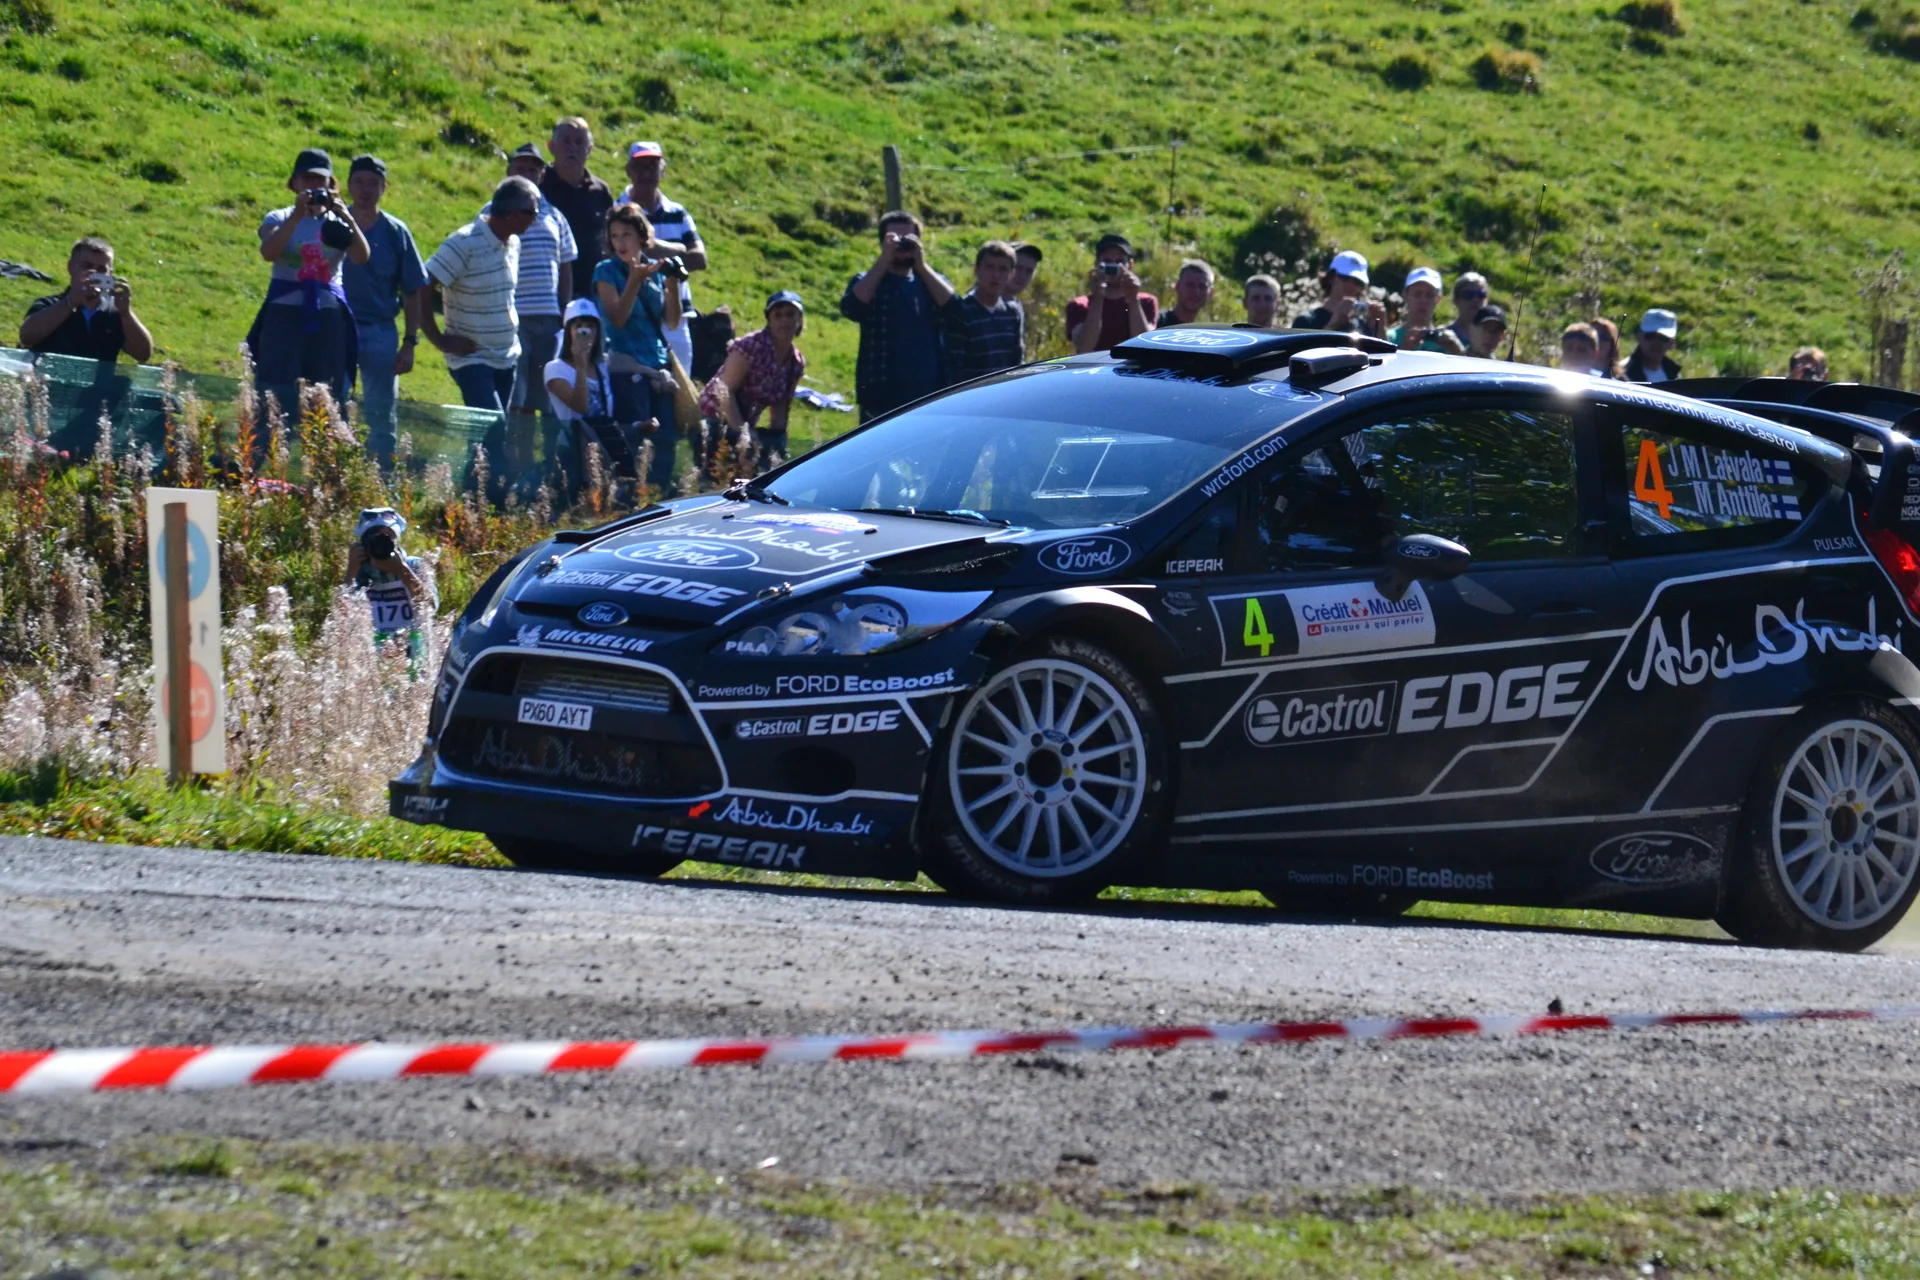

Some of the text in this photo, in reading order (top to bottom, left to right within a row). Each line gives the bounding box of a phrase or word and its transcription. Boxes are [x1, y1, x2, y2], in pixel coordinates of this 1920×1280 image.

[1160, 328, 1233, 345] Ford
[1649, 394, 1745, 432] recommends
[1746, 422, 1800, 454] Castrol
[1201, 433, 1288, 498] wrcford.com
[1667, 443, 1765, 484] J M Latvala
[1634, 439, 1675, 520] 4
[1692, 480, 1773, 519] M Anttila
[630, 540, 738, 566] Ford
[1056, 541, 1116, 569] Ford
[1405, 545, 1432, 557] Ford
[1813, 536, 1857, 551] PULSAR
[1165, 558, 1224, 575] ICEPEAK
[551, 570, 748, 607] Castrol EDGE
[378, 603, 413, 622] 170
[585, 604, 617, 622] Ford
[1302, 595, 1422, 622] Crédit Mutuel
[1243, 598, 1275, 657] 4
[1309, 625, 1321, 634] LA
[1324, 624, 1360, 634] banque
[1375, 620, 1390, 629] qui
[1394, 615, 1425, 627] parler
[545, 627, 655, 653] MICHELIN
[724, 639, 770, 653] PIAA
[699, 668, 956, 698] Powered by FORD EcoBoost
[521, 698, 590, 726] PX60 AYT
[1281, 660, 1591, 739] Castrol EDGE
[752, 709, 902, 737] Castrol EDGE
[1611, 837, 1706, 876] Ford
[1288, 864, 1495, 890] Powered by FORD EcoBoost
